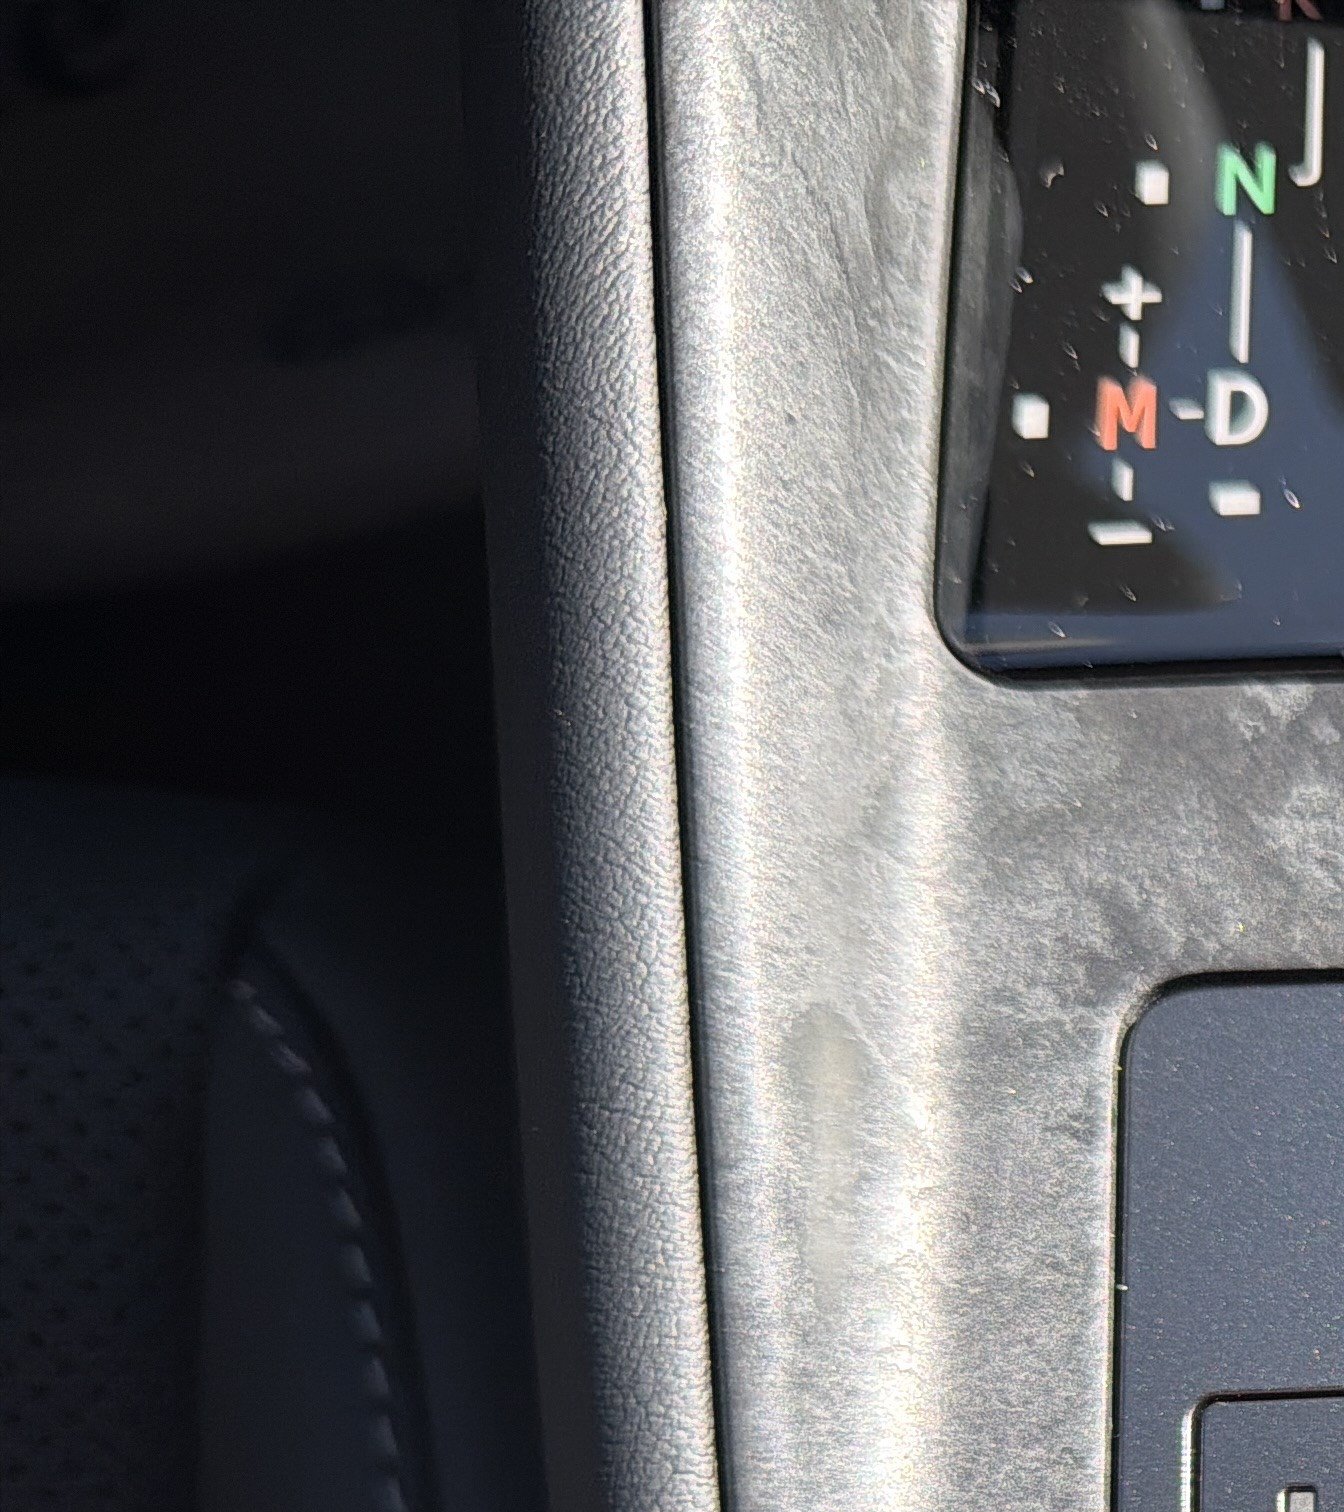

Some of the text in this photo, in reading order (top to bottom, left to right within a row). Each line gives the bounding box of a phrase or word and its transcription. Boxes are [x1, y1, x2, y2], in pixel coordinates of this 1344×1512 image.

[1216, 141, 1277, 216] N
[1096, 366, 1270, 451] M D
